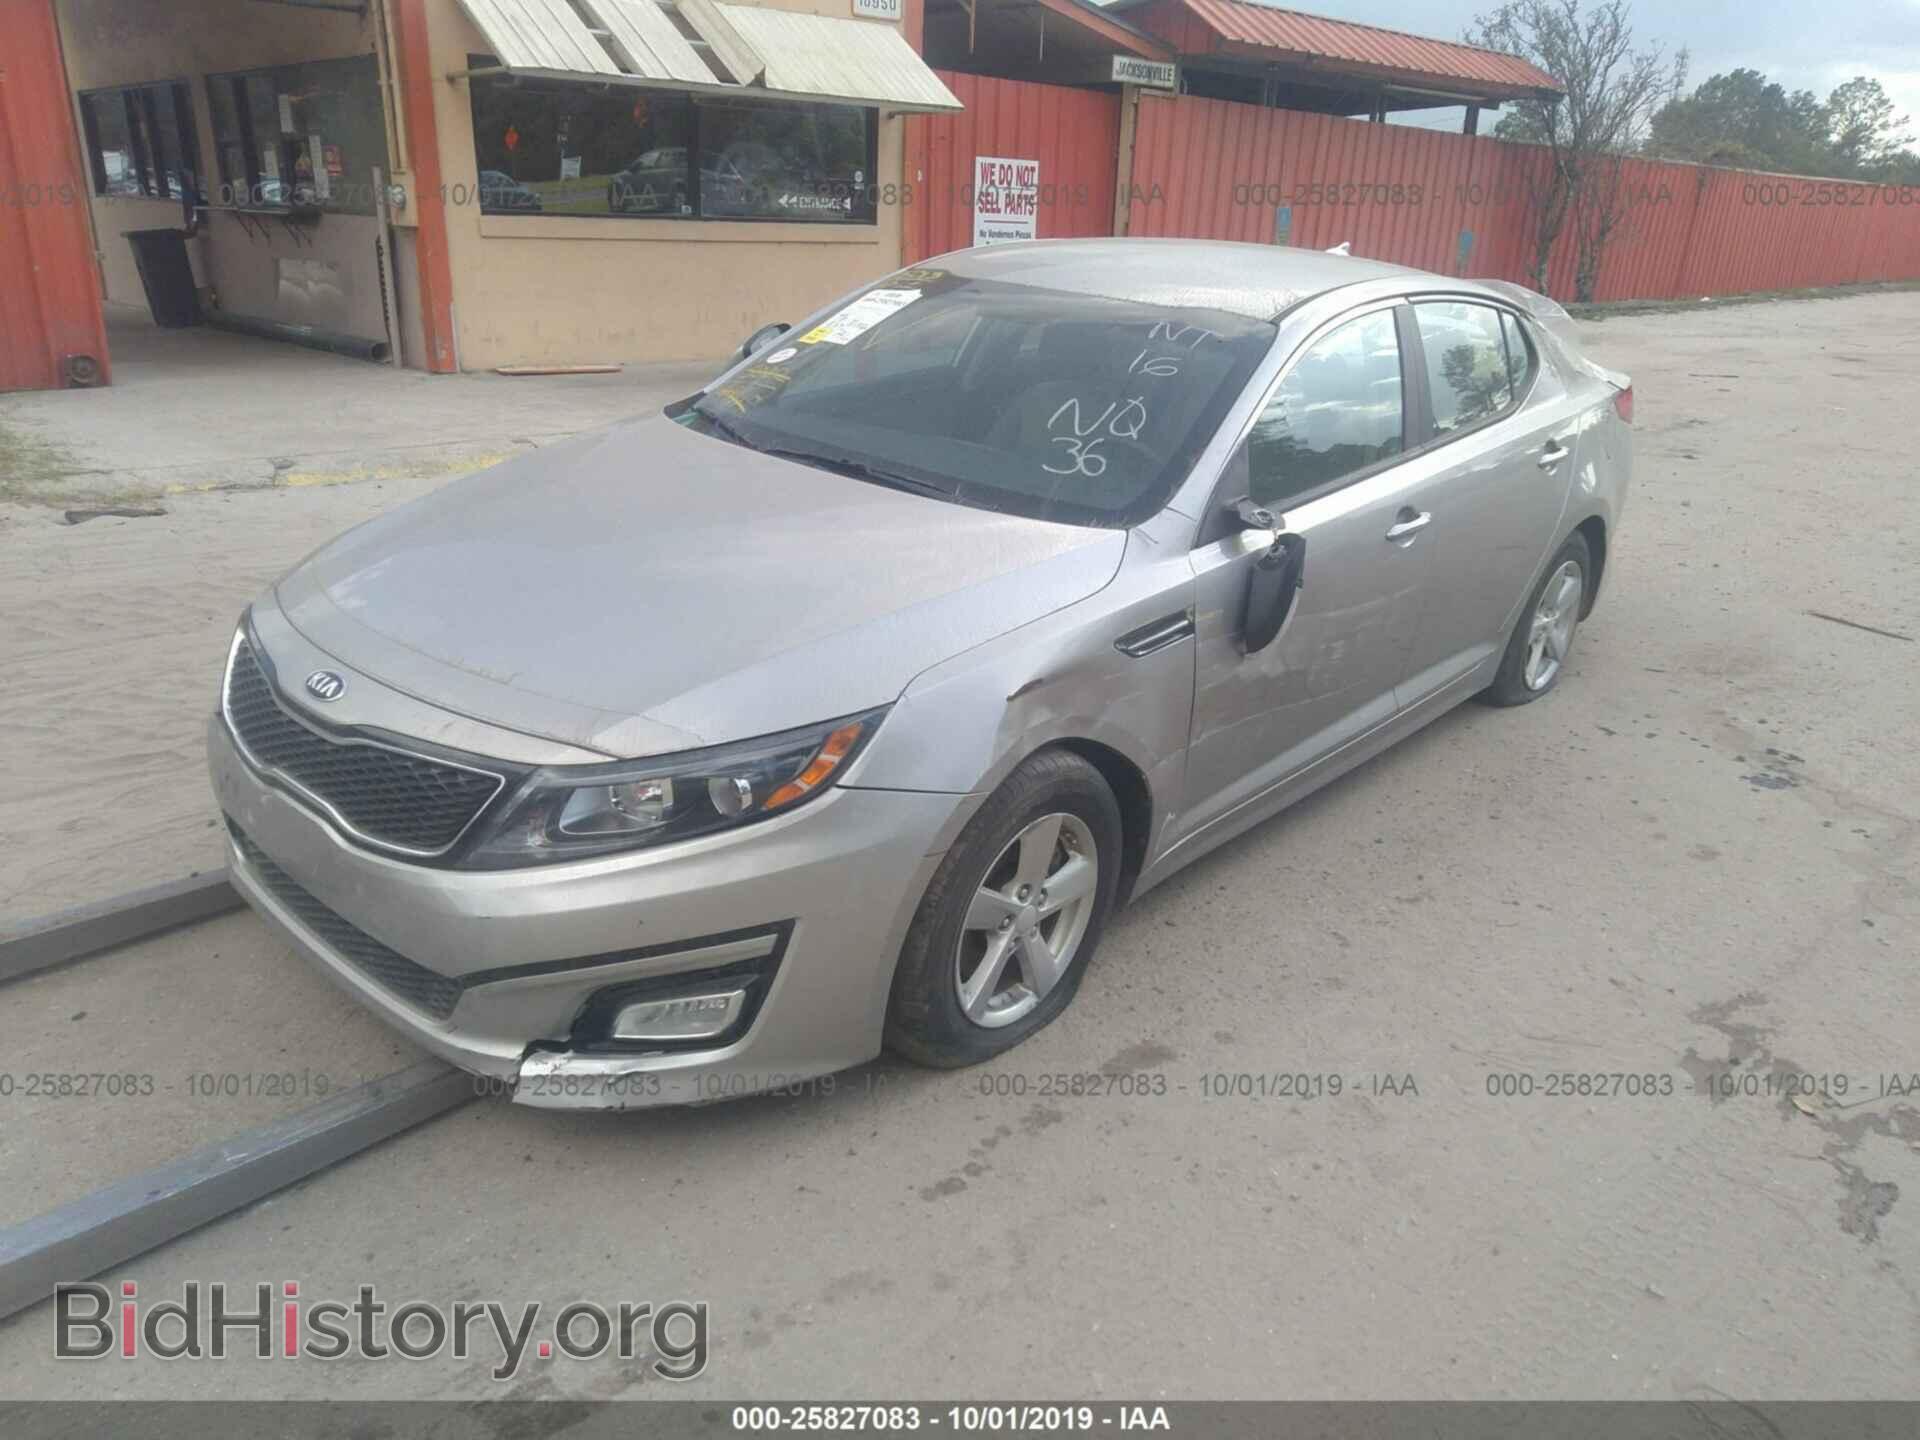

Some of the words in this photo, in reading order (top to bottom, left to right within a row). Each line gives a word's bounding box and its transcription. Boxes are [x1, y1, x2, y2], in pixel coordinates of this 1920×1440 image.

[1116, 62, 1172, 82] JACKSONVILLE
[981, 162, 996, 185] WE
[999, 164, 1013, 186] DO
[1016, 165, 1036, 187] NOT
[978, 191, 1001, 214] SELL
[1005, 193, 1035, 216] PARTS
[1128, 349, 1182, 377] 16
[1042, 437, 1107, 476] 36
[307, 672, 339, 697] KIA
